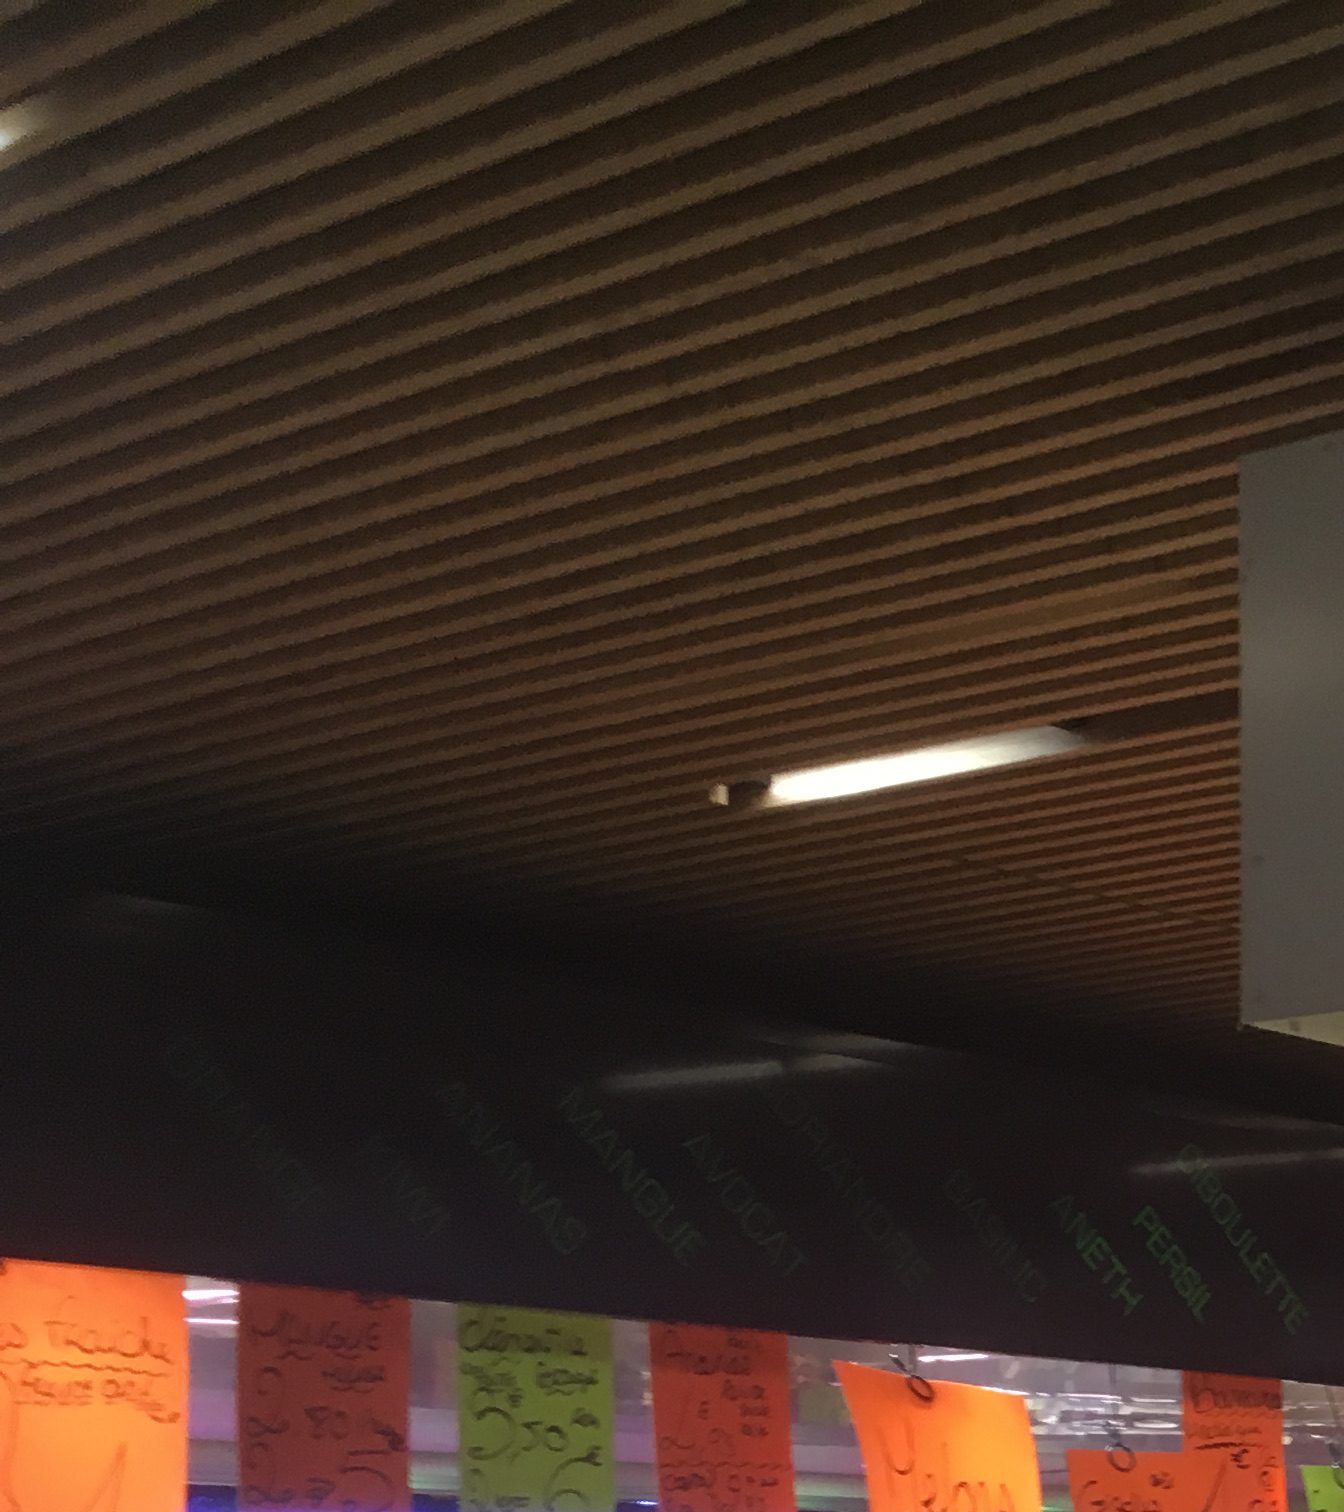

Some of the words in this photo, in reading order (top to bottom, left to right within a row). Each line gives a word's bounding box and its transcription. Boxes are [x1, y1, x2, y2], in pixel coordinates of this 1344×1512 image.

[558, 1084, 705, 1267] MANGUE
[682, 1132, 807, 1277] AVOCAT
[1177, 1143, 1310, 1335] CIBOULETTE
[1052, 1194, 1144, 1317] ANETH
[1133, 1204, 1213, 1324] PERSIL
